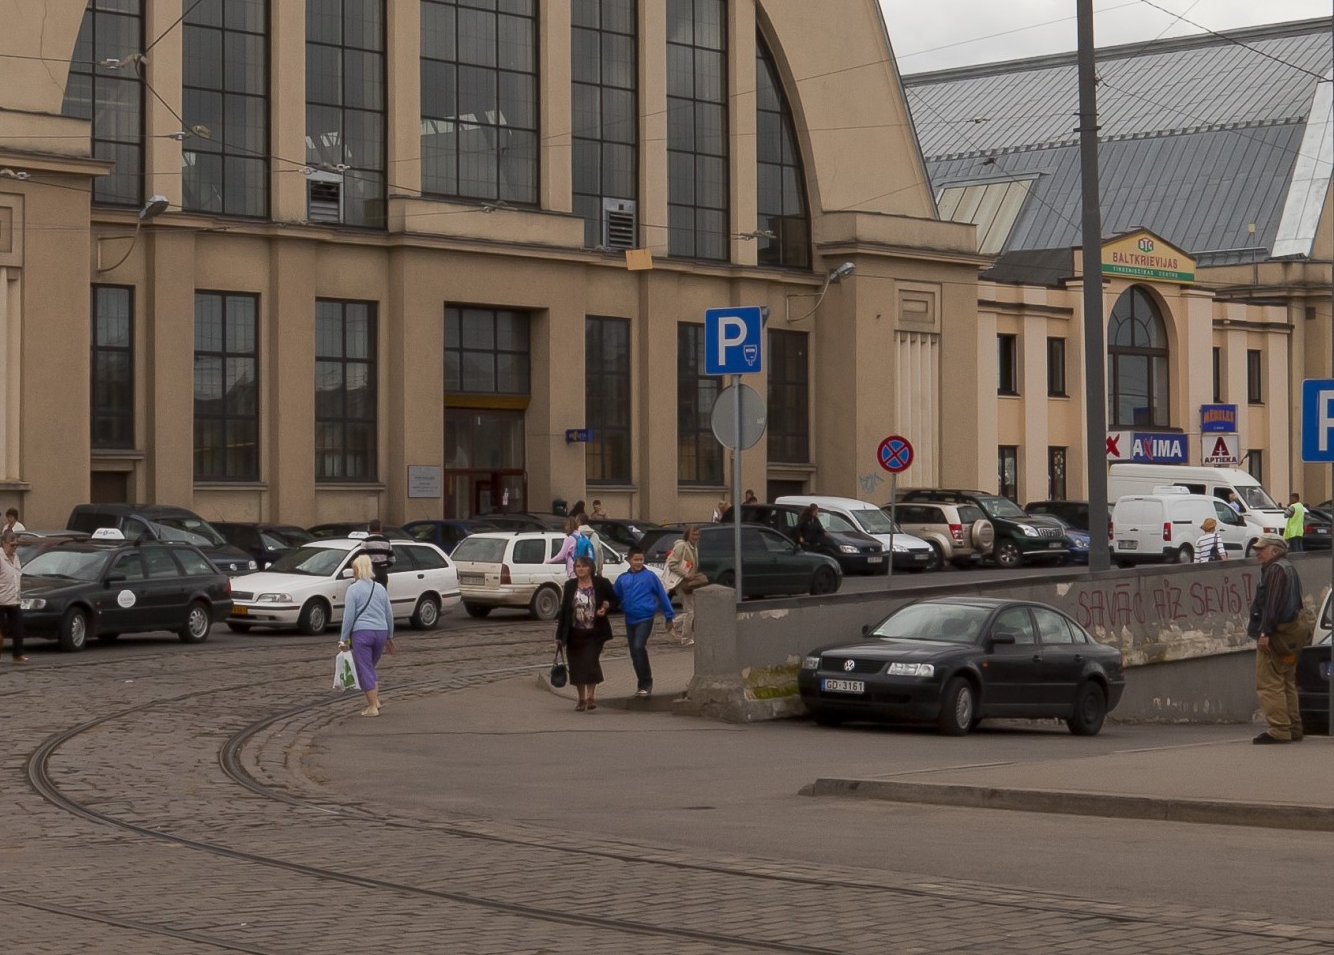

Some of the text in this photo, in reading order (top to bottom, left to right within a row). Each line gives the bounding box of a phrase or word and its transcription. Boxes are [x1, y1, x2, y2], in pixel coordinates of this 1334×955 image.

[1112, 251, 1178, 269] BALTKRIEVIJAS
[718, 316, 747, 366] P
[1204, 456, 1237, 464] APTIEKA
